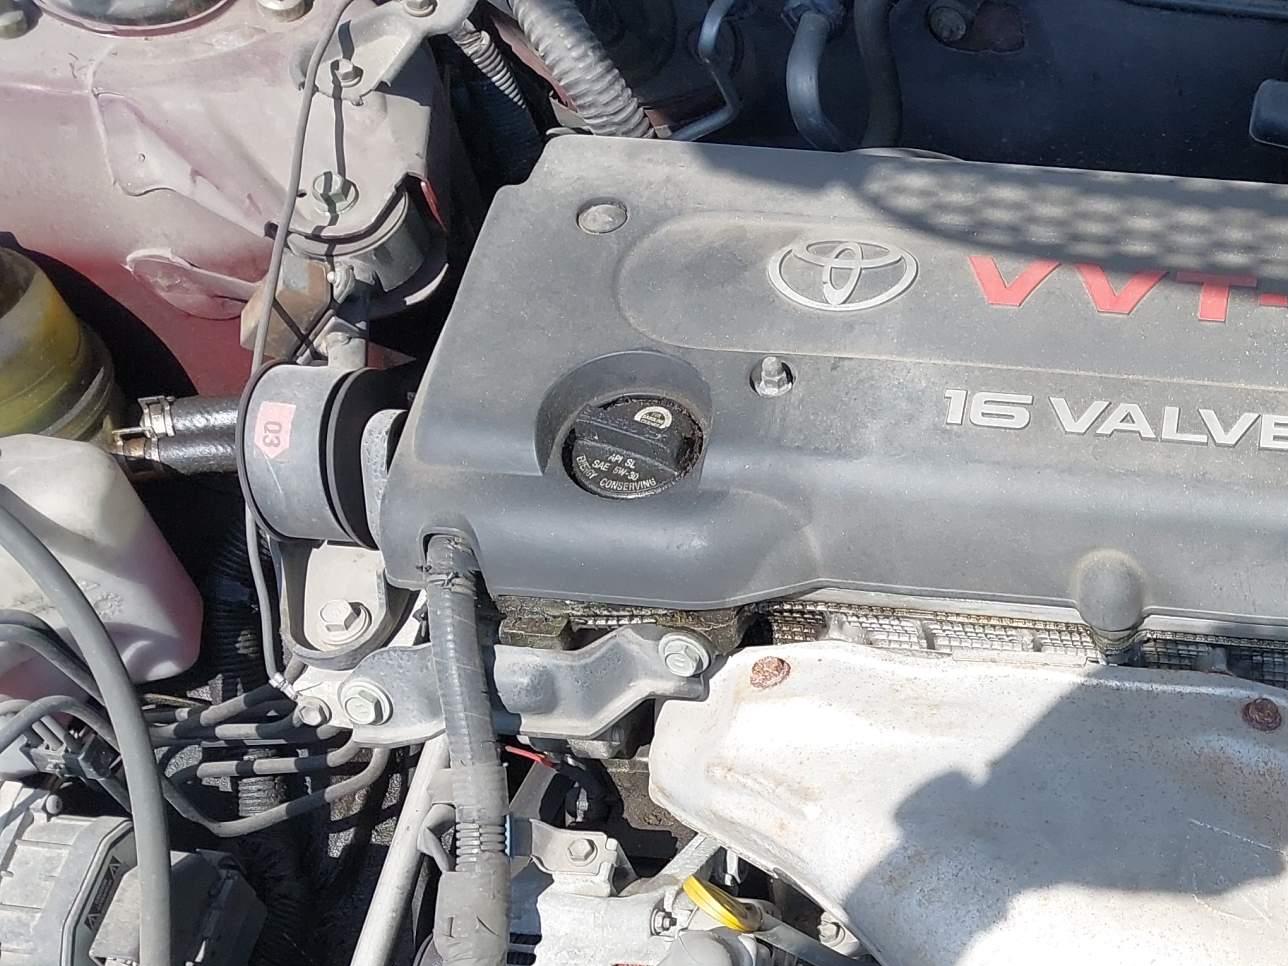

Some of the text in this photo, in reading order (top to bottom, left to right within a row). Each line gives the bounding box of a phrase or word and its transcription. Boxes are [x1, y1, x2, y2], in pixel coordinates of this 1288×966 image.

[944, 388, 1034, 429] 16
[591, 459, 639, 481] SAE 5W-30
[608, 453, 636, 469] API SL
[599, 477, 657, 491] CONSERVING
